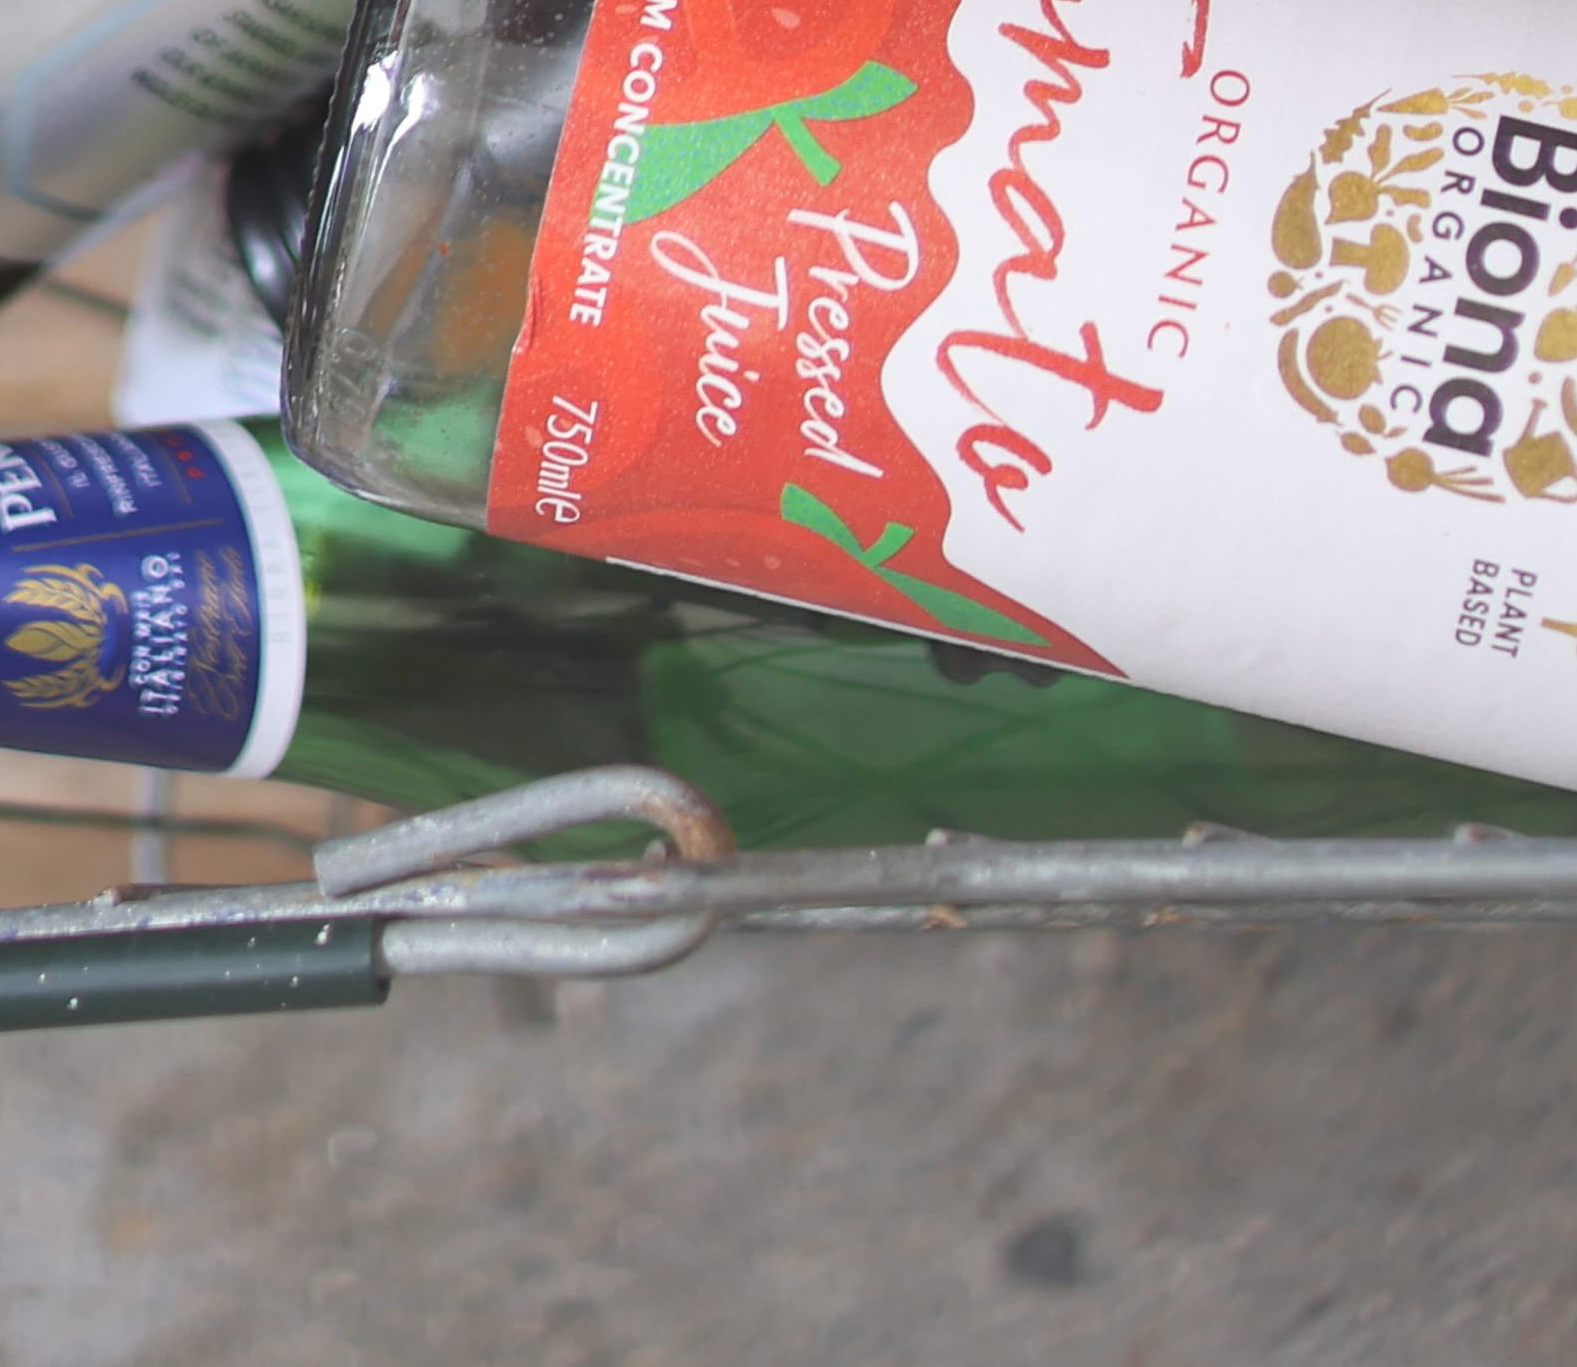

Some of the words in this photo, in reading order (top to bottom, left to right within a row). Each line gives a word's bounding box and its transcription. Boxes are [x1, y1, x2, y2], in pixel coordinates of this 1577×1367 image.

[568, 41, 664, 328] CONCENTRATE
[1147, 69, 1252, 360] ORGANIC
[1388, 124, 1486, 414] ORGANIC
[653, 230, 793, 449] Juice
[787, 202, 921, 480] Pressed
[133, 645, 152, 685] CON
[139, 554, 175, 714] ITALIANO
[1452, 560, 1500, 649] BASED
[1491, 568, 1536, 658] PLANT
